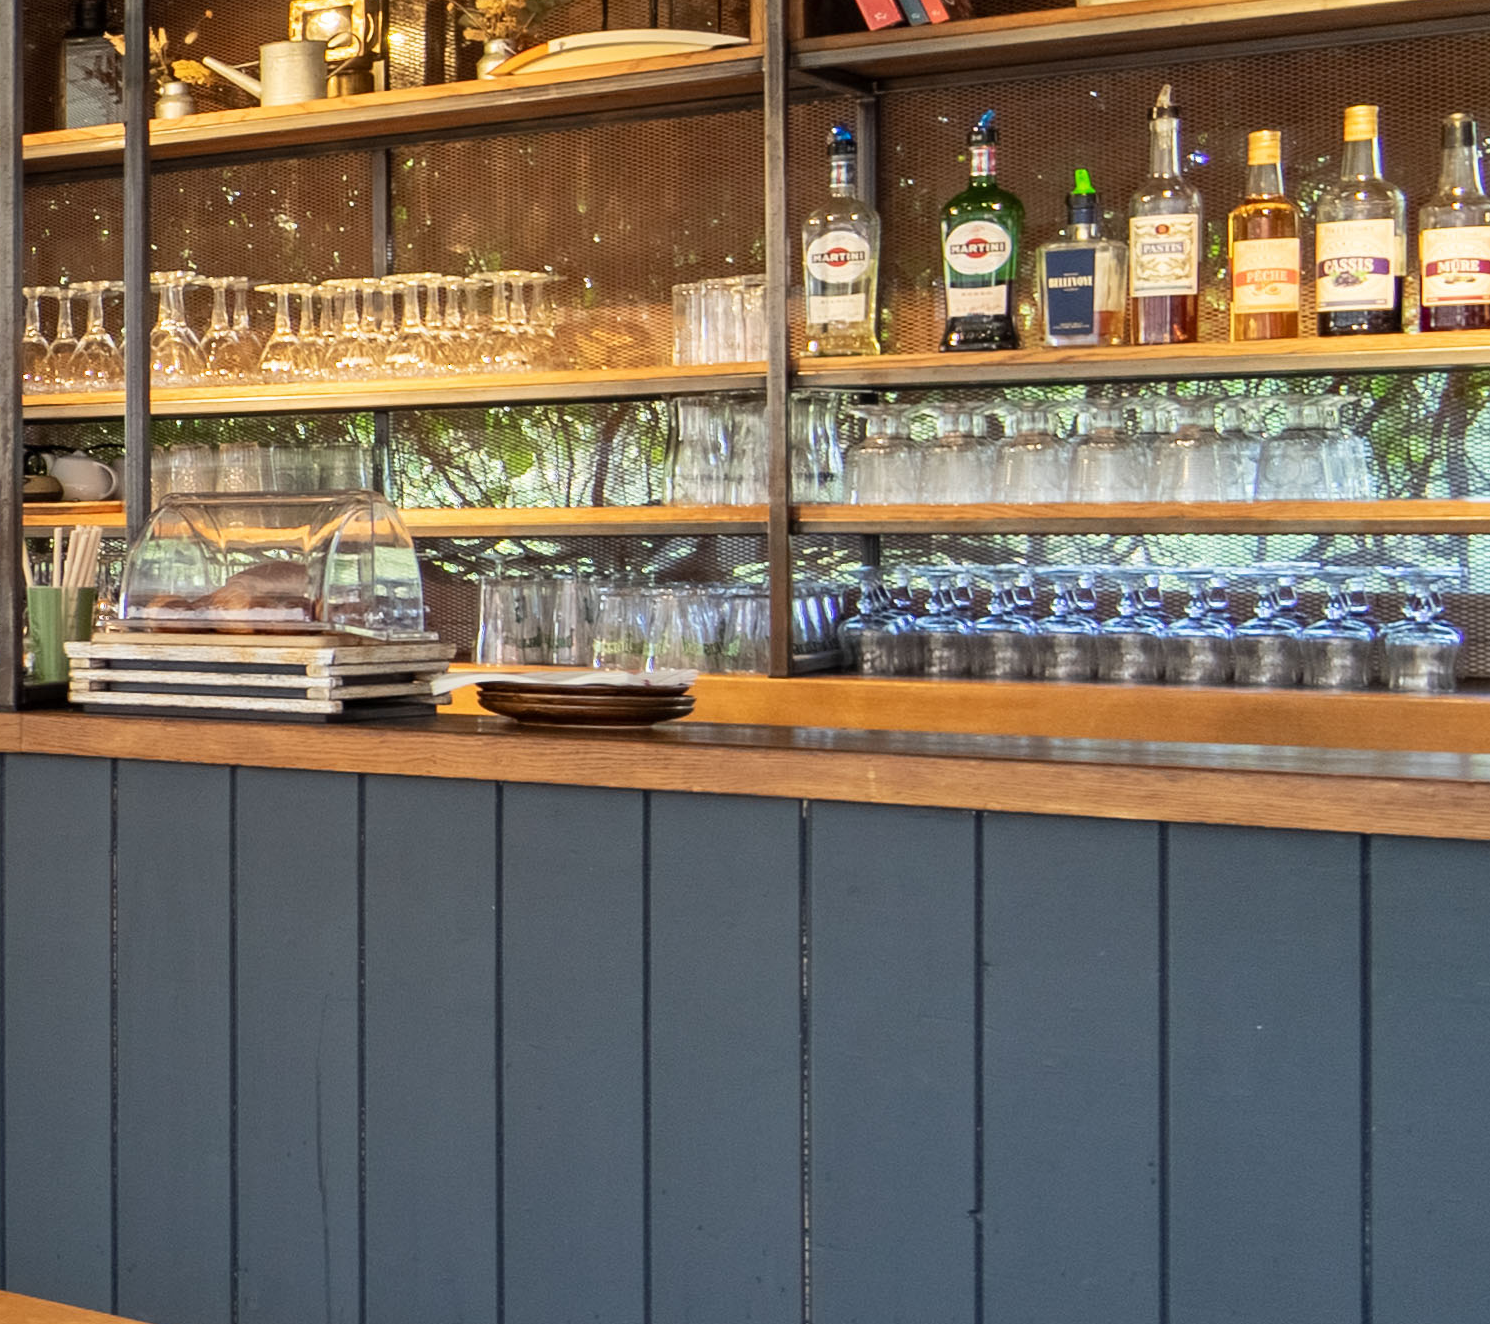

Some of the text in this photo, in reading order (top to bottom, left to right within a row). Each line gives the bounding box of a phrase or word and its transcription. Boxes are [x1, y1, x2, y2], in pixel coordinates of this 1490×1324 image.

[951, 242, 1005, 255] MARTINI
[1143, 242, 1183, 254] PASTIS
[812, 251, 865, 263] MARTINI
[1323, 257, 1374, 273] CASSIS
[1437, 258, 1480, 274] MÛRE
[1246, 269, 1288, 283] PÊCHE
